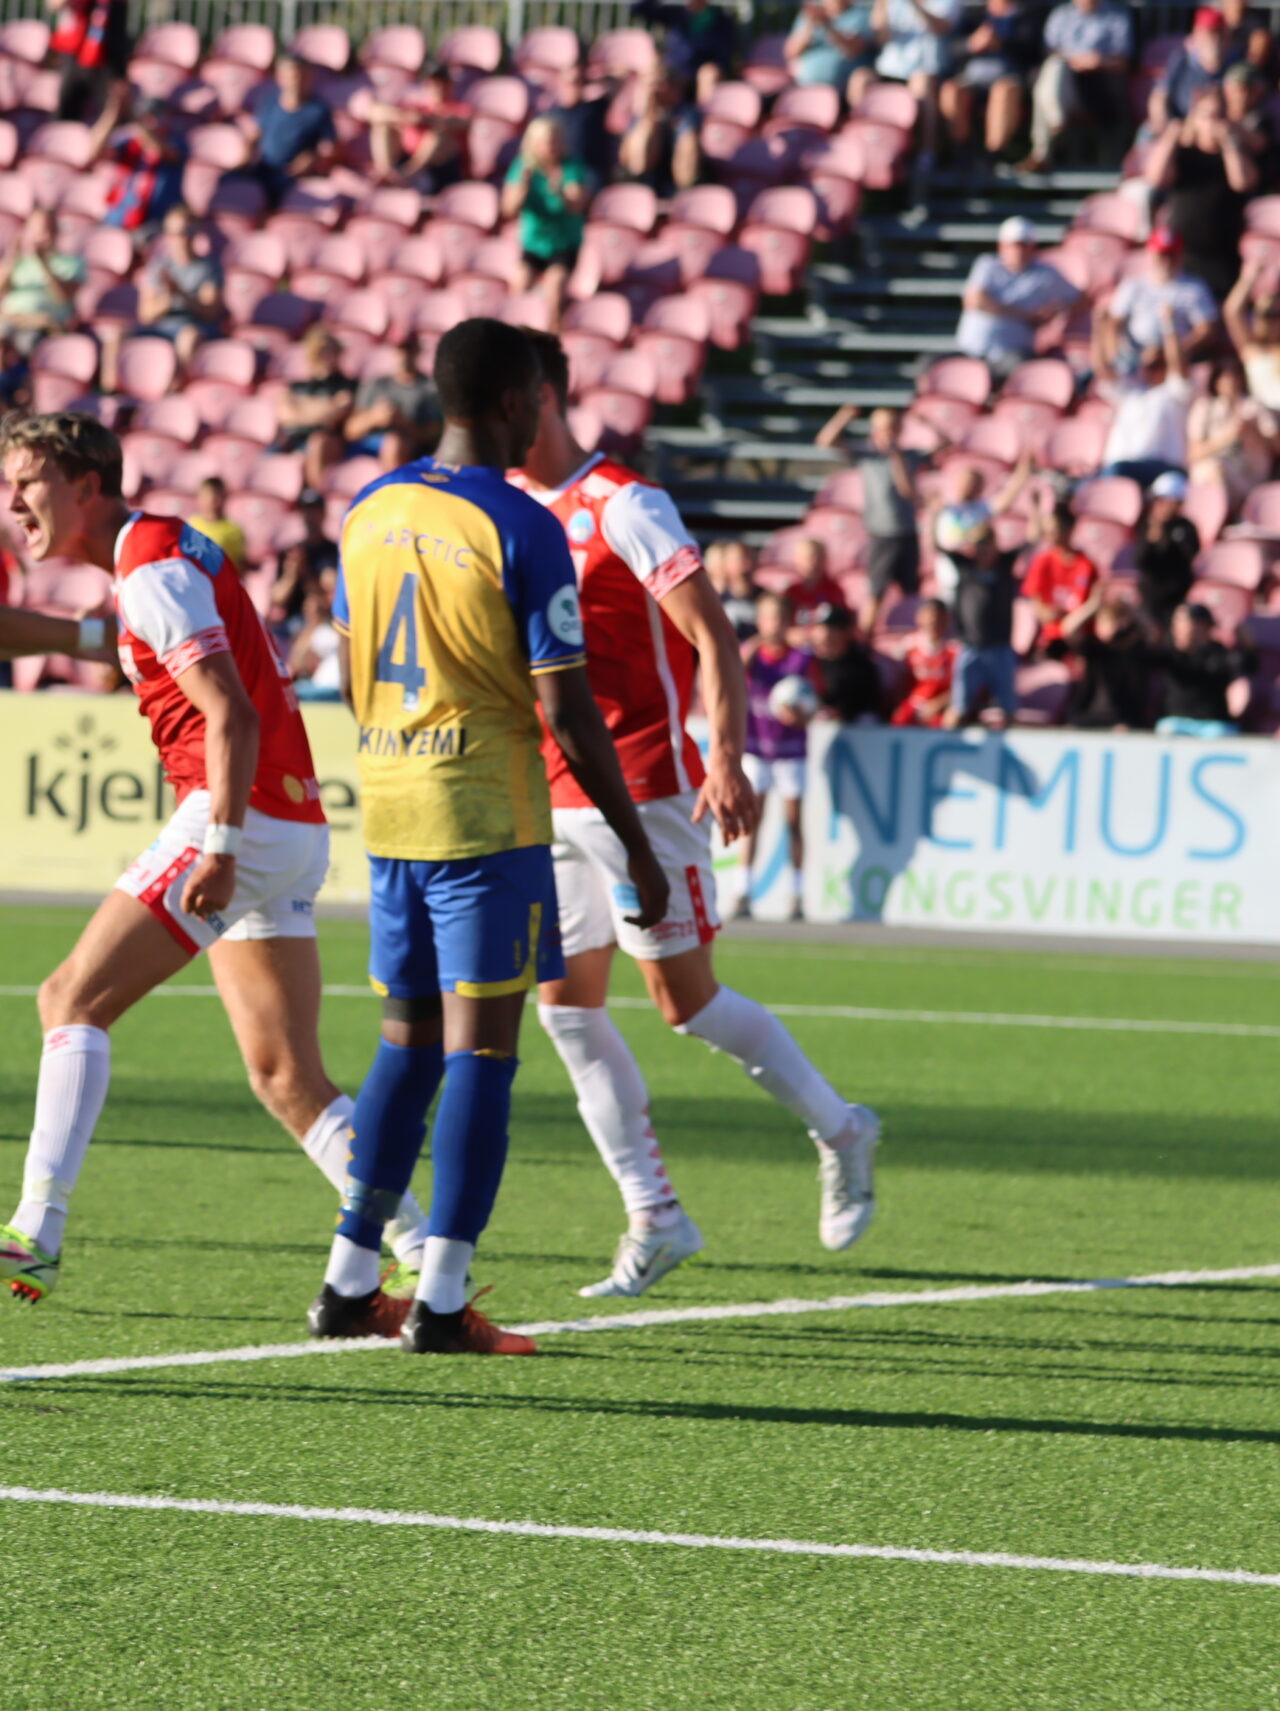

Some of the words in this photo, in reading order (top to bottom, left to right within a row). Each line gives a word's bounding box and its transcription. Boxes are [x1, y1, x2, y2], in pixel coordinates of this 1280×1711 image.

[383, 528, 473, 568] ARCTIC
[375, 572, 427, 711] 4
[358, 725, 467, 757] KINYEMI
[828, 735, 1249, 860] NEMUS
[825, 864, 1244, 931] KONGSVINGER
